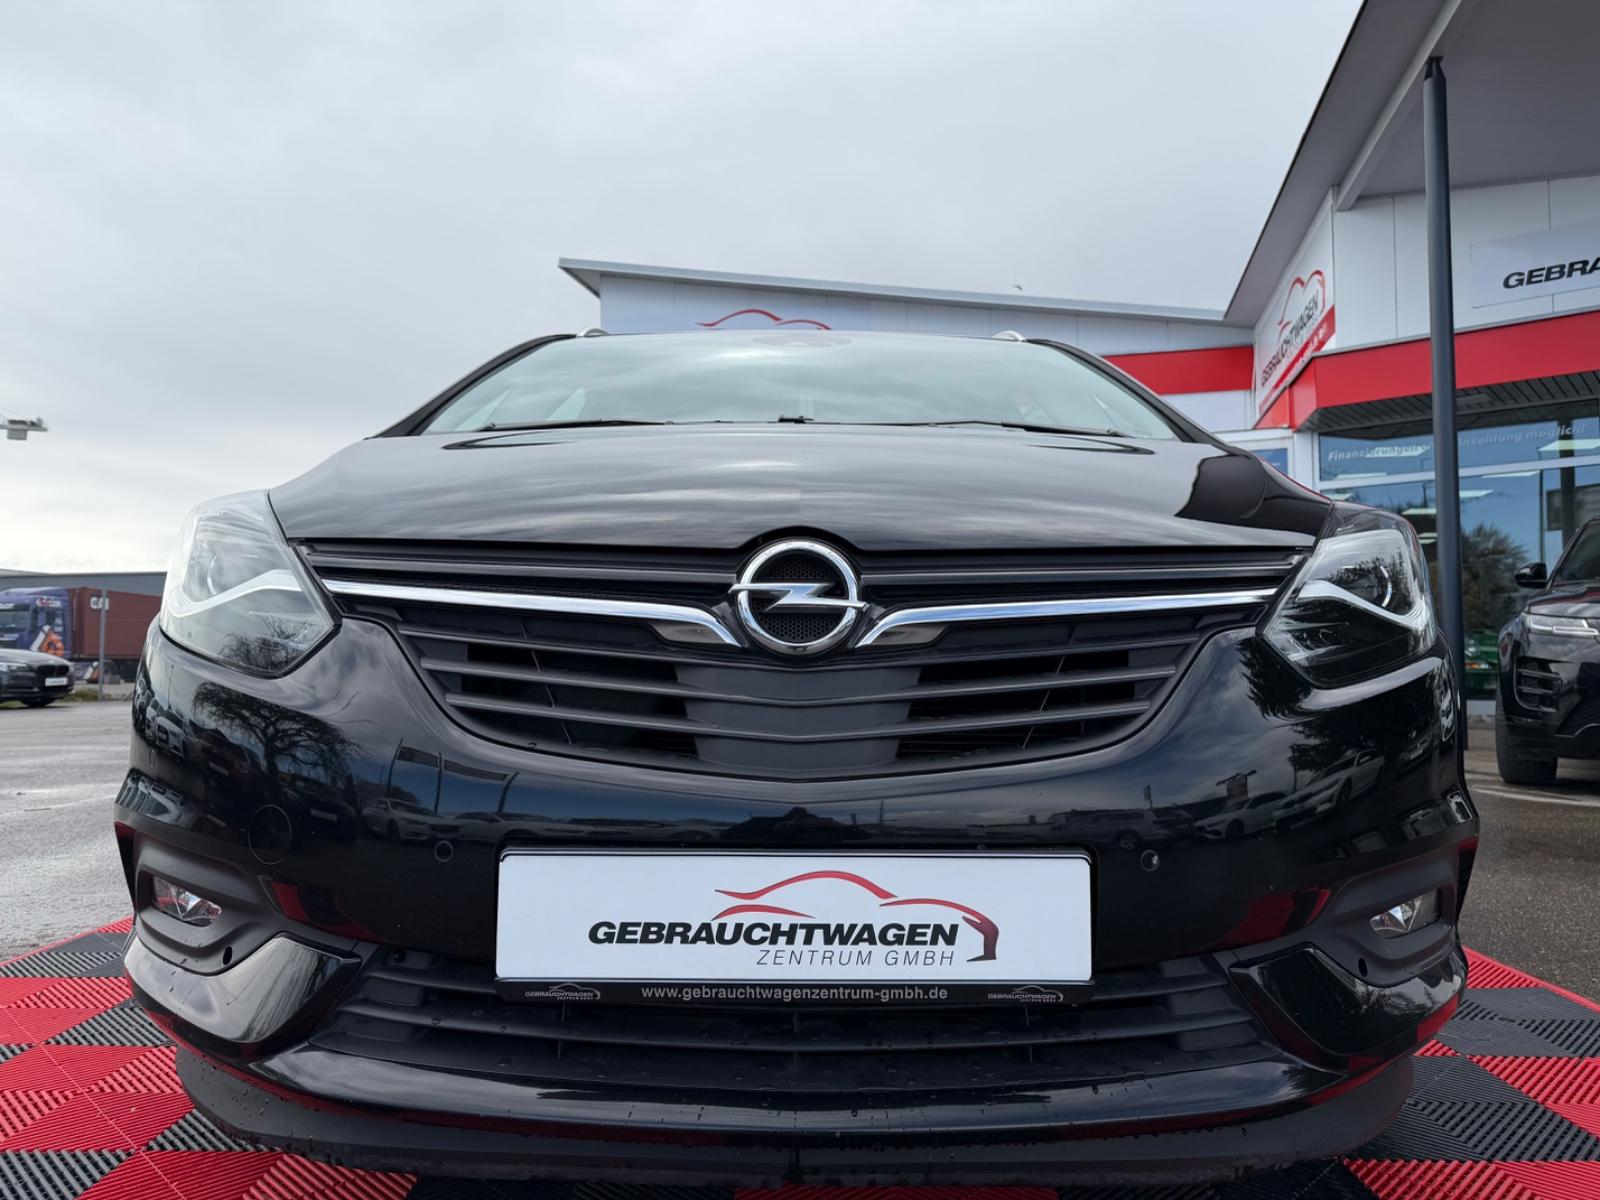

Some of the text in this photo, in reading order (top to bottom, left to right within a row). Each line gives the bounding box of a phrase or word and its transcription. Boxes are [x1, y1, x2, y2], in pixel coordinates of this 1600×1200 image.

[588, 921, 959, 946] GEBRAUCHTWAGEN
[756, 949, 955, 967] ZENTRUM GMBH
[641, 984, 948, 1002] www.gebrauchtwagenzentrum-gmbh.de
